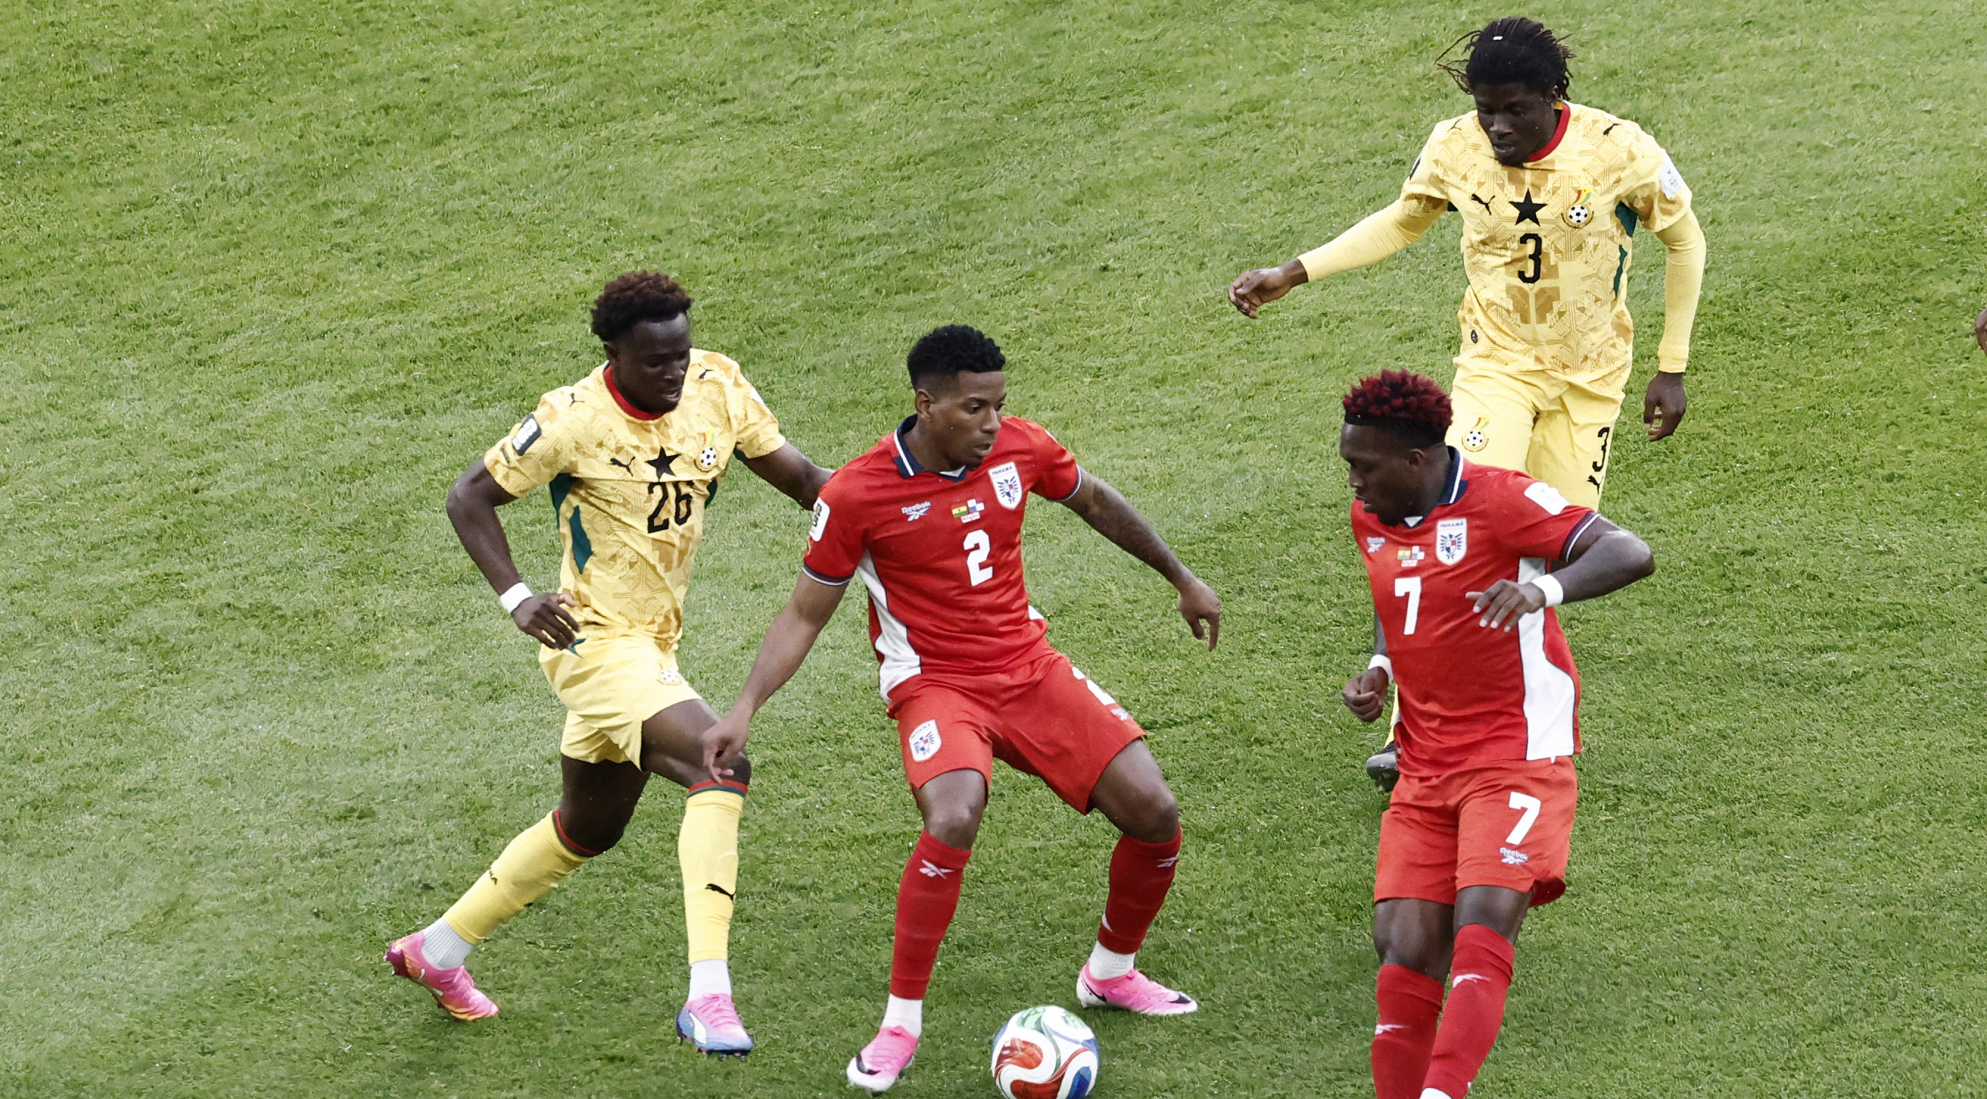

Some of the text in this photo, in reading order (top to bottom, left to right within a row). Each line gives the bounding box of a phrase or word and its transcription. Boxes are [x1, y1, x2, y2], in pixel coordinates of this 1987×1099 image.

[1518, 233, 1542, 284] 3
[1592, 426, 1611, 472] 3
[647, 481, 694, 533] 26
[901, 501, 931, 515] Reebok
[963, 529, 994, 587] 2
[1394, 576, 1421, 635] 7
[1505, 791, 1541, 846] 7
